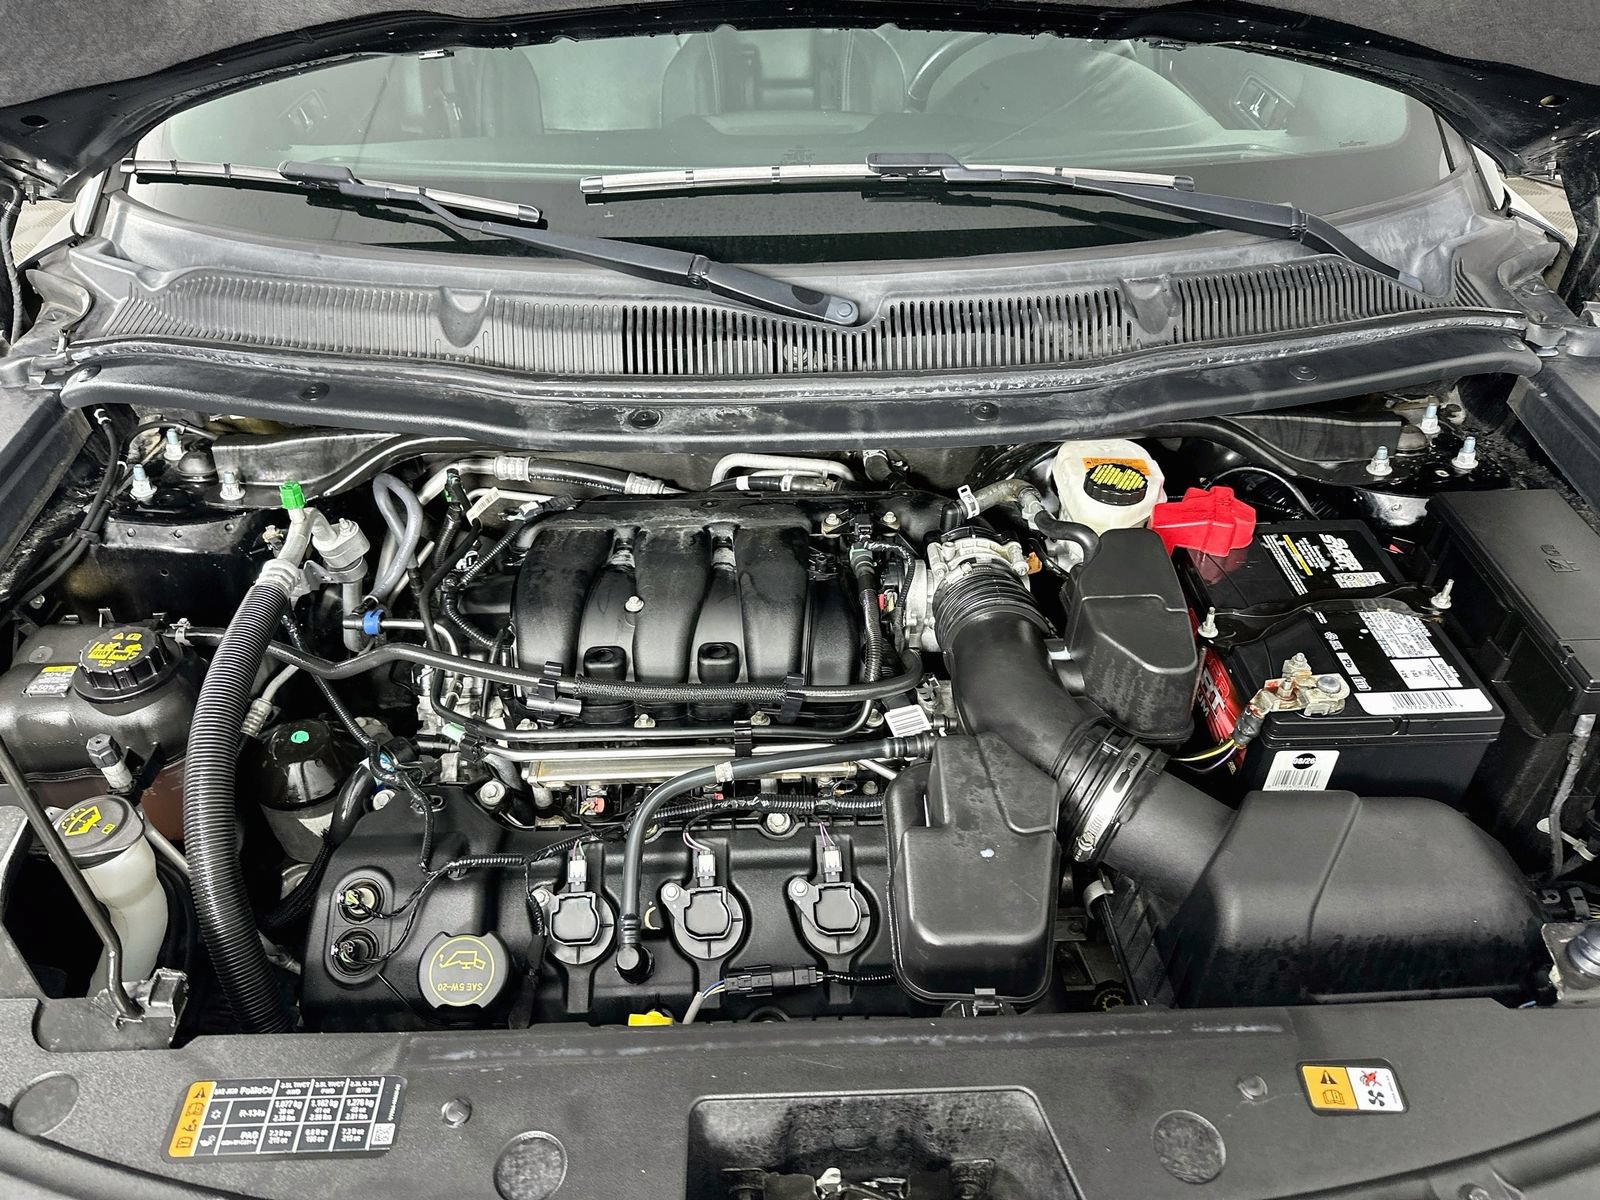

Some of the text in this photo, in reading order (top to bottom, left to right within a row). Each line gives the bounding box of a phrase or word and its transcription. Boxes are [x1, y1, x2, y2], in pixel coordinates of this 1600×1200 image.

[1342, 658, 1352, 668] Pb
[437, 982, 484, 992] SAE 5W-20
[239, 1086, 274, 1096] FoMoCo
[293, 1100, 303, 1110] kg
[329, 1099, 339, 1109] kg
[365, 1098, 375, 1108] kg
[240, 1131, 259, 1140] PAG
